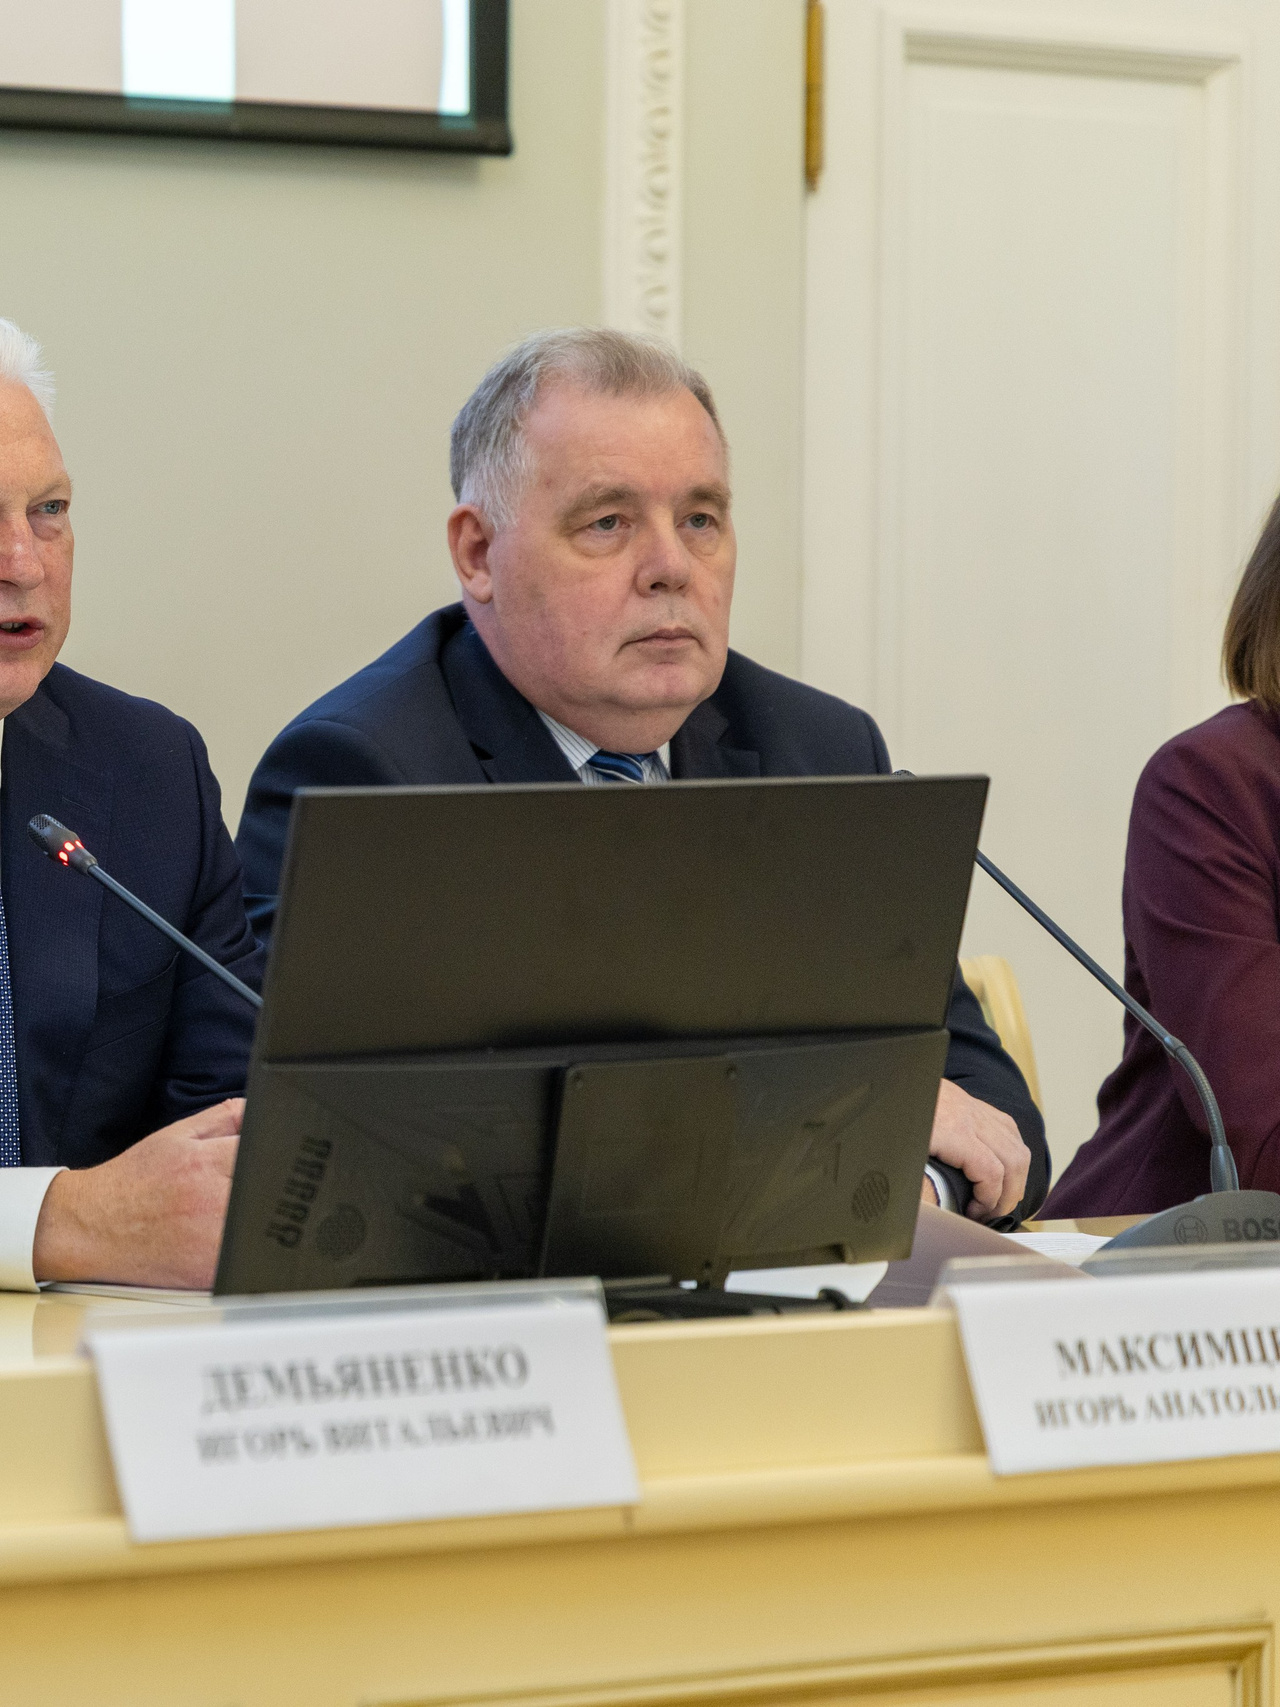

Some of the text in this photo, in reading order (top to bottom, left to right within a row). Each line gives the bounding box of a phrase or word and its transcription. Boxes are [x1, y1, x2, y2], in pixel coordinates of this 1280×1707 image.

[1222, 1216, 1280, 1242] BOS
[200, 1344, 530, 1414] ДЕМЬЯНЕНКО
[196, 1404, 556, 1466] ИГОРЬ ВИТАЛЬЕВИЧ
[1034, 1391, 1137, 1430] ИГОРЬ
